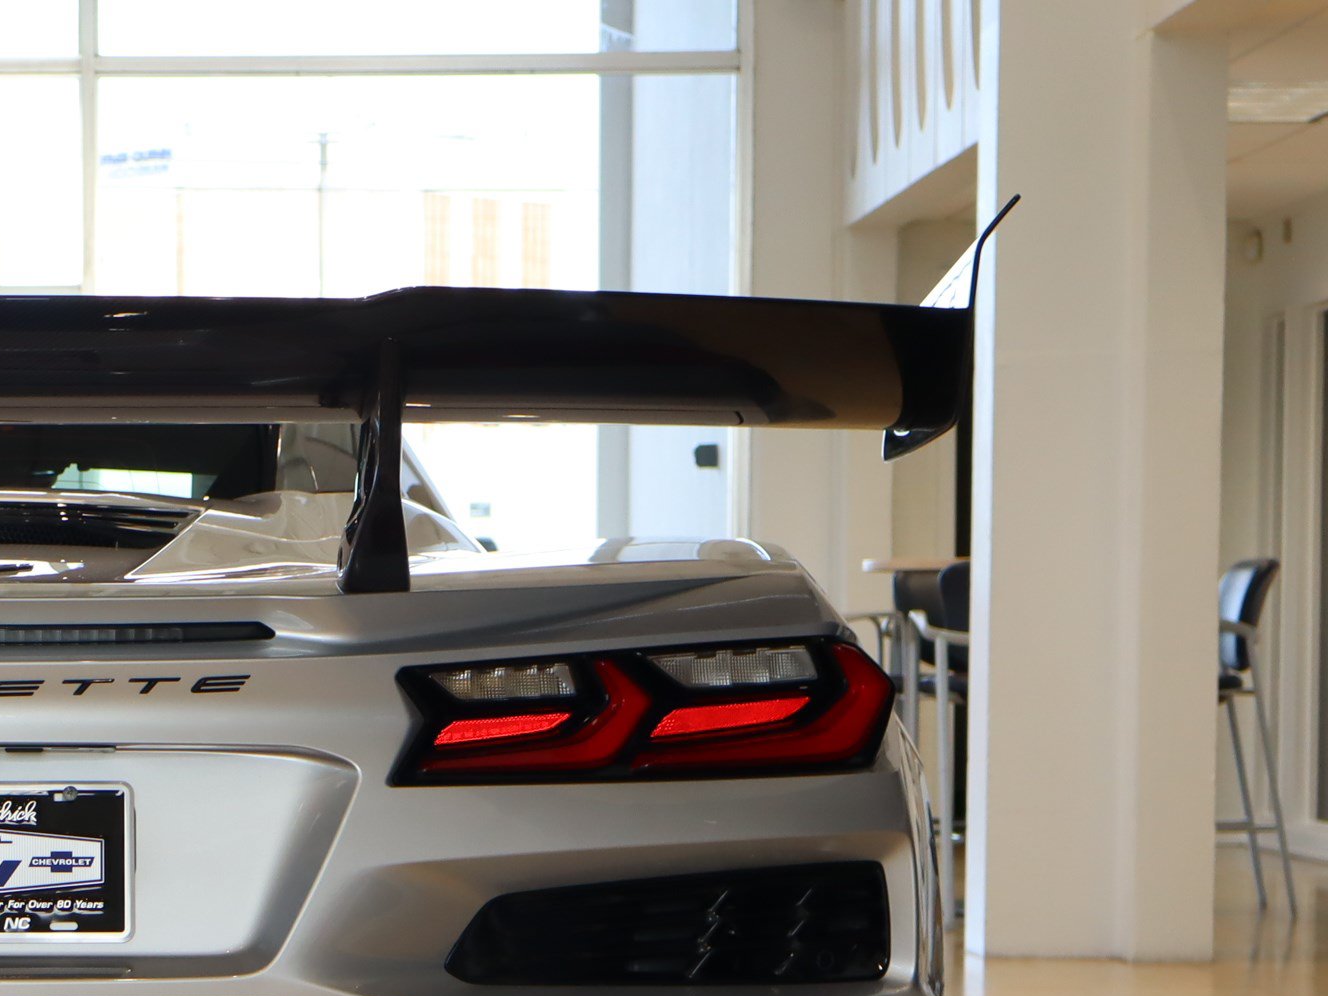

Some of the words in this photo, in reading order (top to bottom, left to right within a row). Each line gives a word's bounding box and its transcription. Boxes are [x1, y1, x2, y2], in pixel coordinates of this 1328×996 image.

[31, 858, 92, 866] CHEVROLET
[7, 899, 26, 909] For
[28, 899, 53, 909] Over
[75, 899, 104, 909] Years
[4, 917, 31, 931] NC
